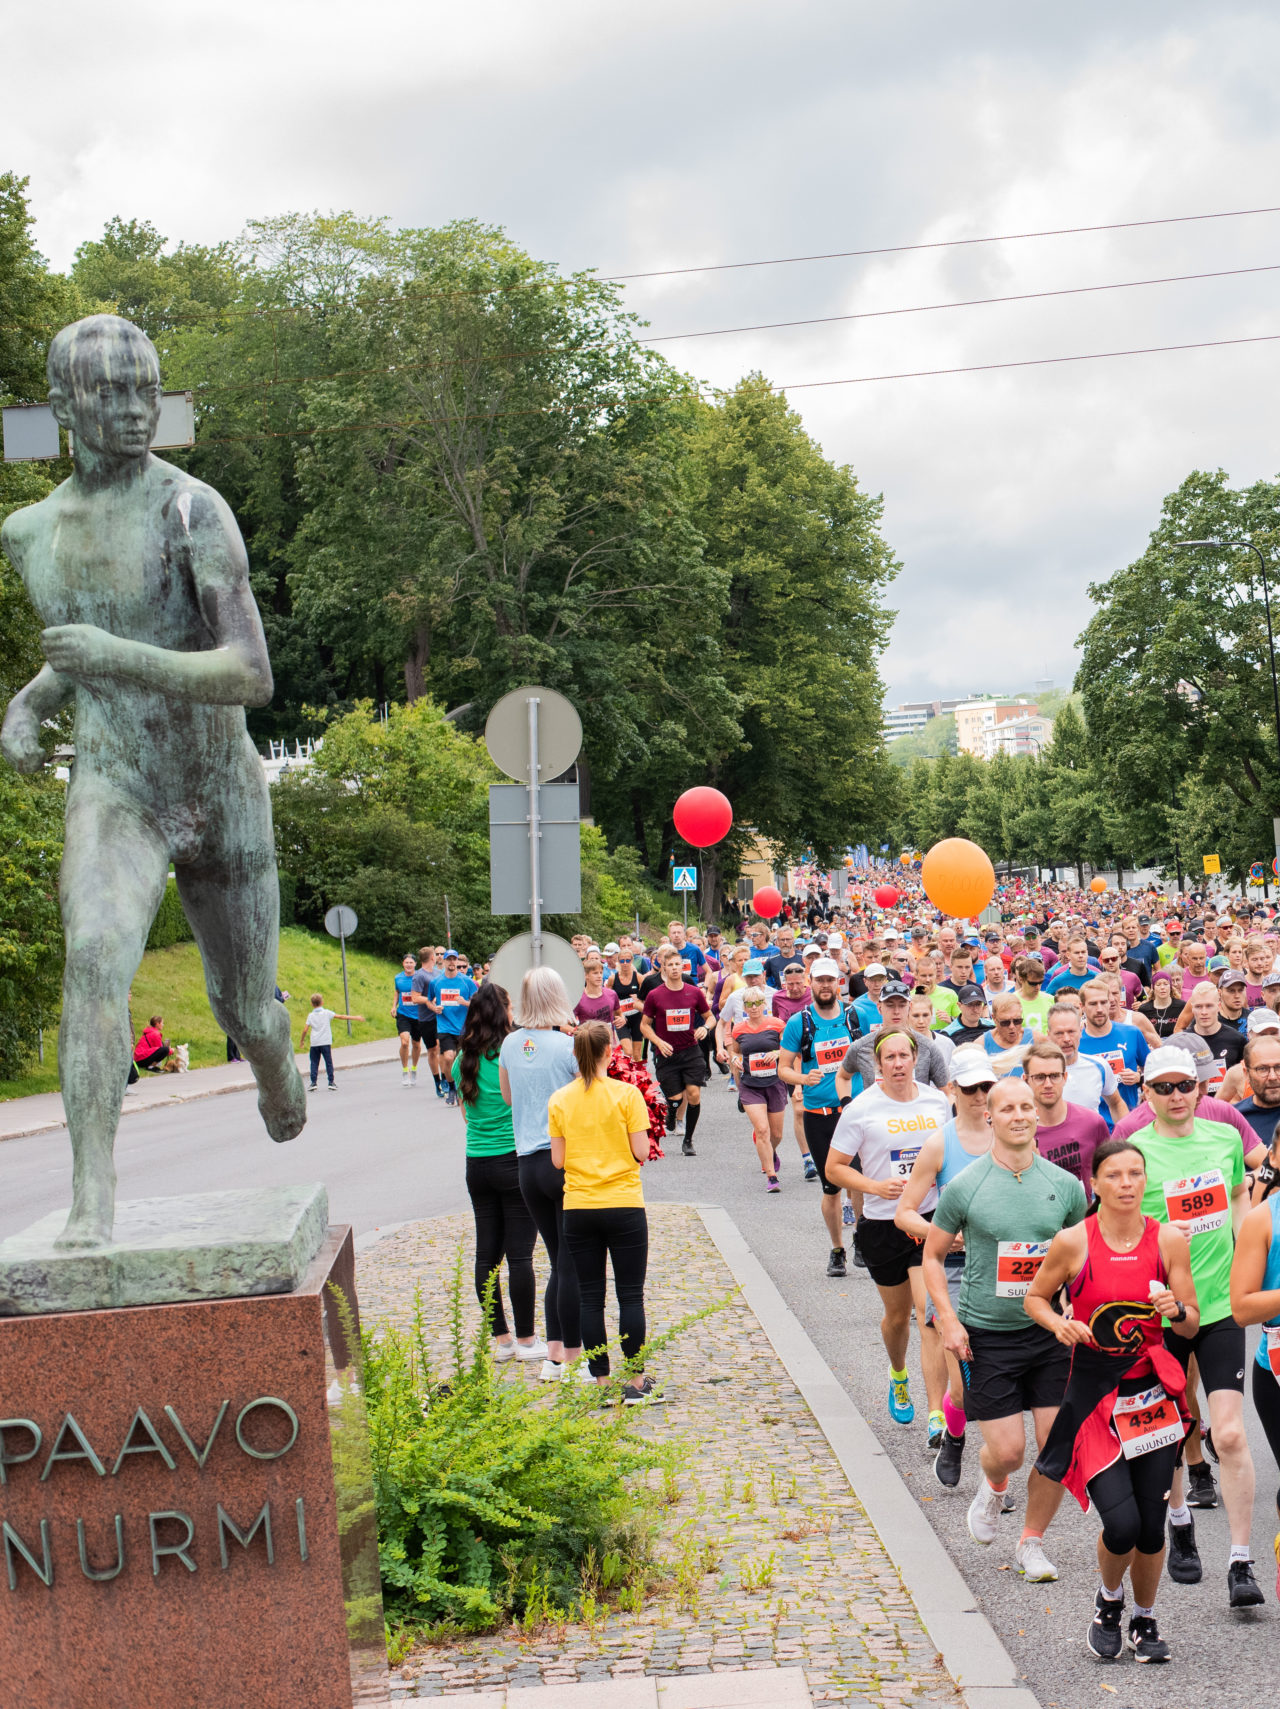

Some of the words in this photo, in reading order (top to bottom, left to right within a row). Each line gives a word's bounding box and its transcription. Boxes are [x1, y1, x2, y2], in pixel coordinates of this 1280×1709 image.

[824, 1049, 843, 1060] 610
[887, 1114, 938, 1134] Stella
[1047, 1141, 1080, 1161] PAAVO
[898, 1163, 914, 1175] 37
[1181, 1192, 1214, 1213] 589
[1129, 1406, 1166, 1428] 434
[0, 1396, 299, 1485] PAAVO
[1135, 1433, 1177, 1455] SUUNTO
[3, 1497, 308, 1591] NURMI
